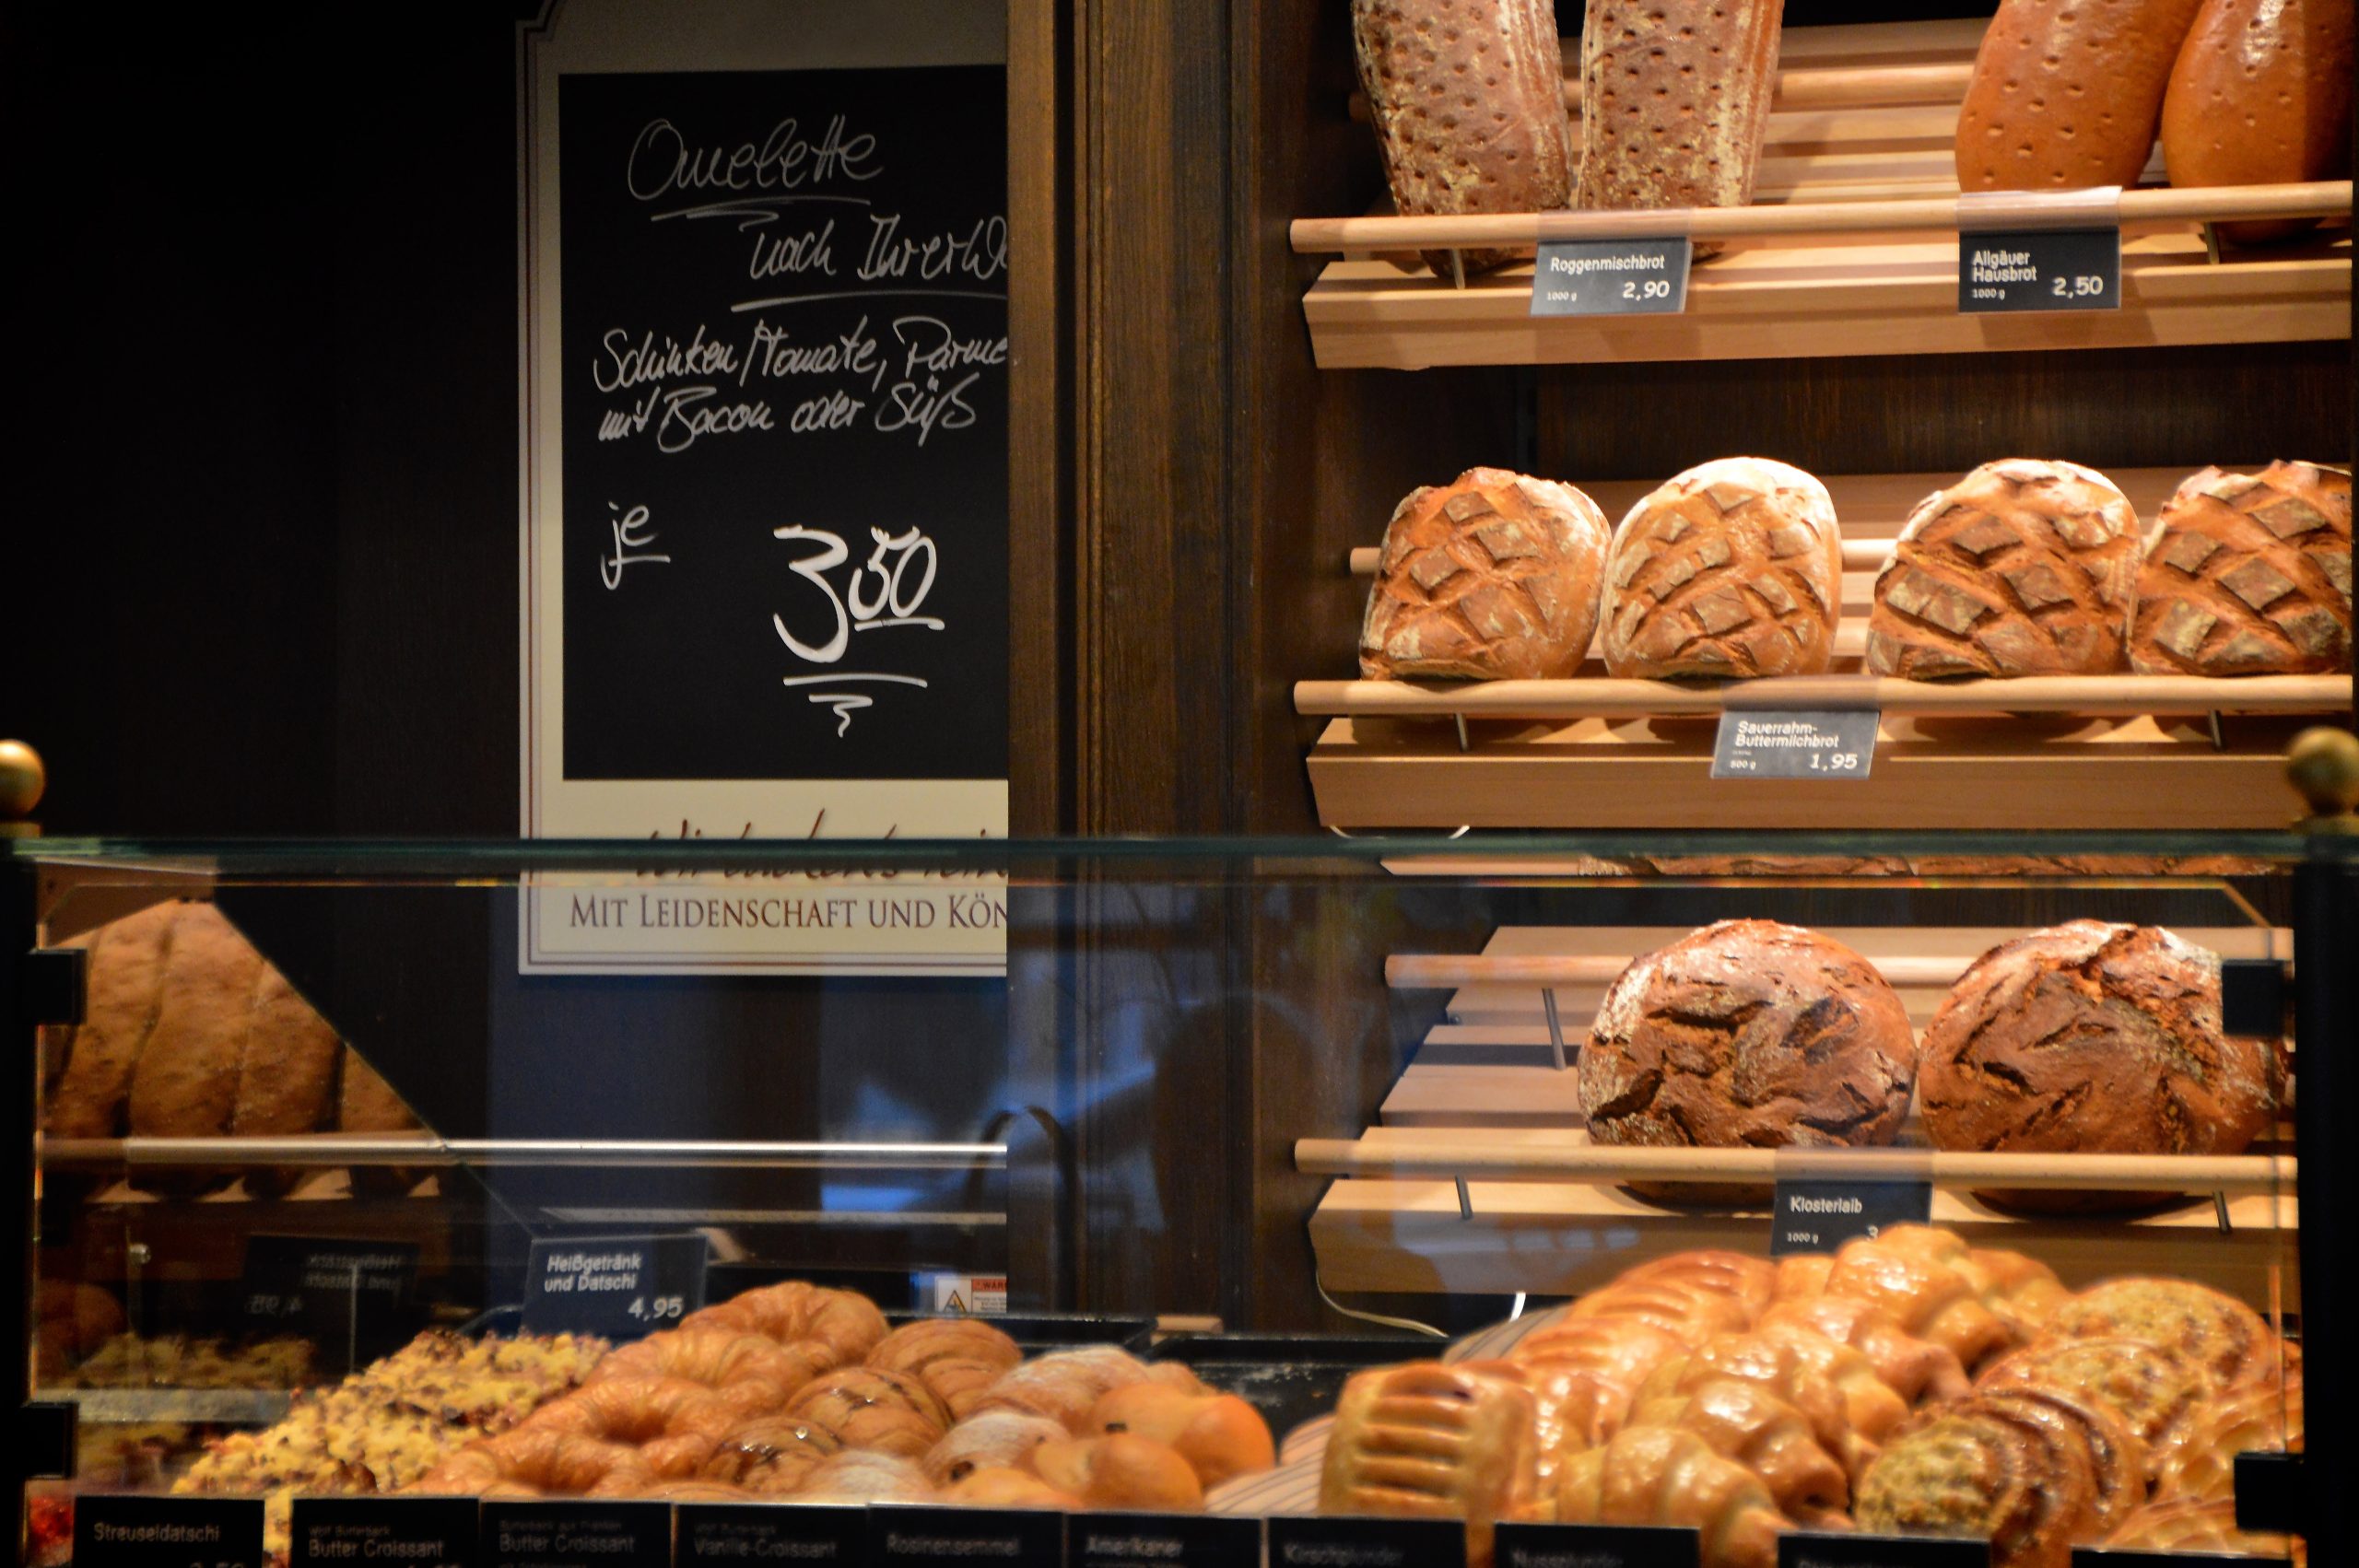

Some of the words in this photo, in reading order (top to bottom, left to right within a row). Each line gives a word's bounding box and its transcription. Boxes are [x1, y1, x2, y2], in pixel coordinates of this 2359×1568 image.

[750, 218, 837, 279] nach
[1550, 254, 1665, 275] Roggenmischbrot
[1972, 250, 2031, 269] Allgäuer
[1972, 266, 2037, 283] Hausbrot
[1546, 291, 1569, 301] 1000
[1571, 292, 1578, 302] g
[1623, 279, 1671, 302] 2,90
[1972, 288, 1997, 298] 1000
[1998, 288, 2006, 300] g
[2051, 275, 2105, 299] 2,50
[598, 386, 661, 441] mit
[657, 385, 775, 453] Bacon
[790, 390, 865, 433] oder
[1738, 720, 1818, 735] Sauerrahm-
[1734, 734, 1840, 748] Buttermilchbrot
[1809, 753, 1859, 772] 1,95
[1790, 1196, 1863, 1213] Klosterlaib
[1786, 1232, 1811, 1243] 1000
[546, 1253, 642, 1274] Heißgetränk
[544, 1275, 574, 1292] und
[578, 1272, 638, 1291] Datschi
[628, 1296, 684, 1321] 4,95
[93, 1521, 222, 1543] Streuseldatschi
[309, 1539, 360, 1558] Butter
[363, 1537, 445, 1558] Croissant
[499, 1533, 550, 1553] Butter
[554, 1533, 635, 1553] Croissant
